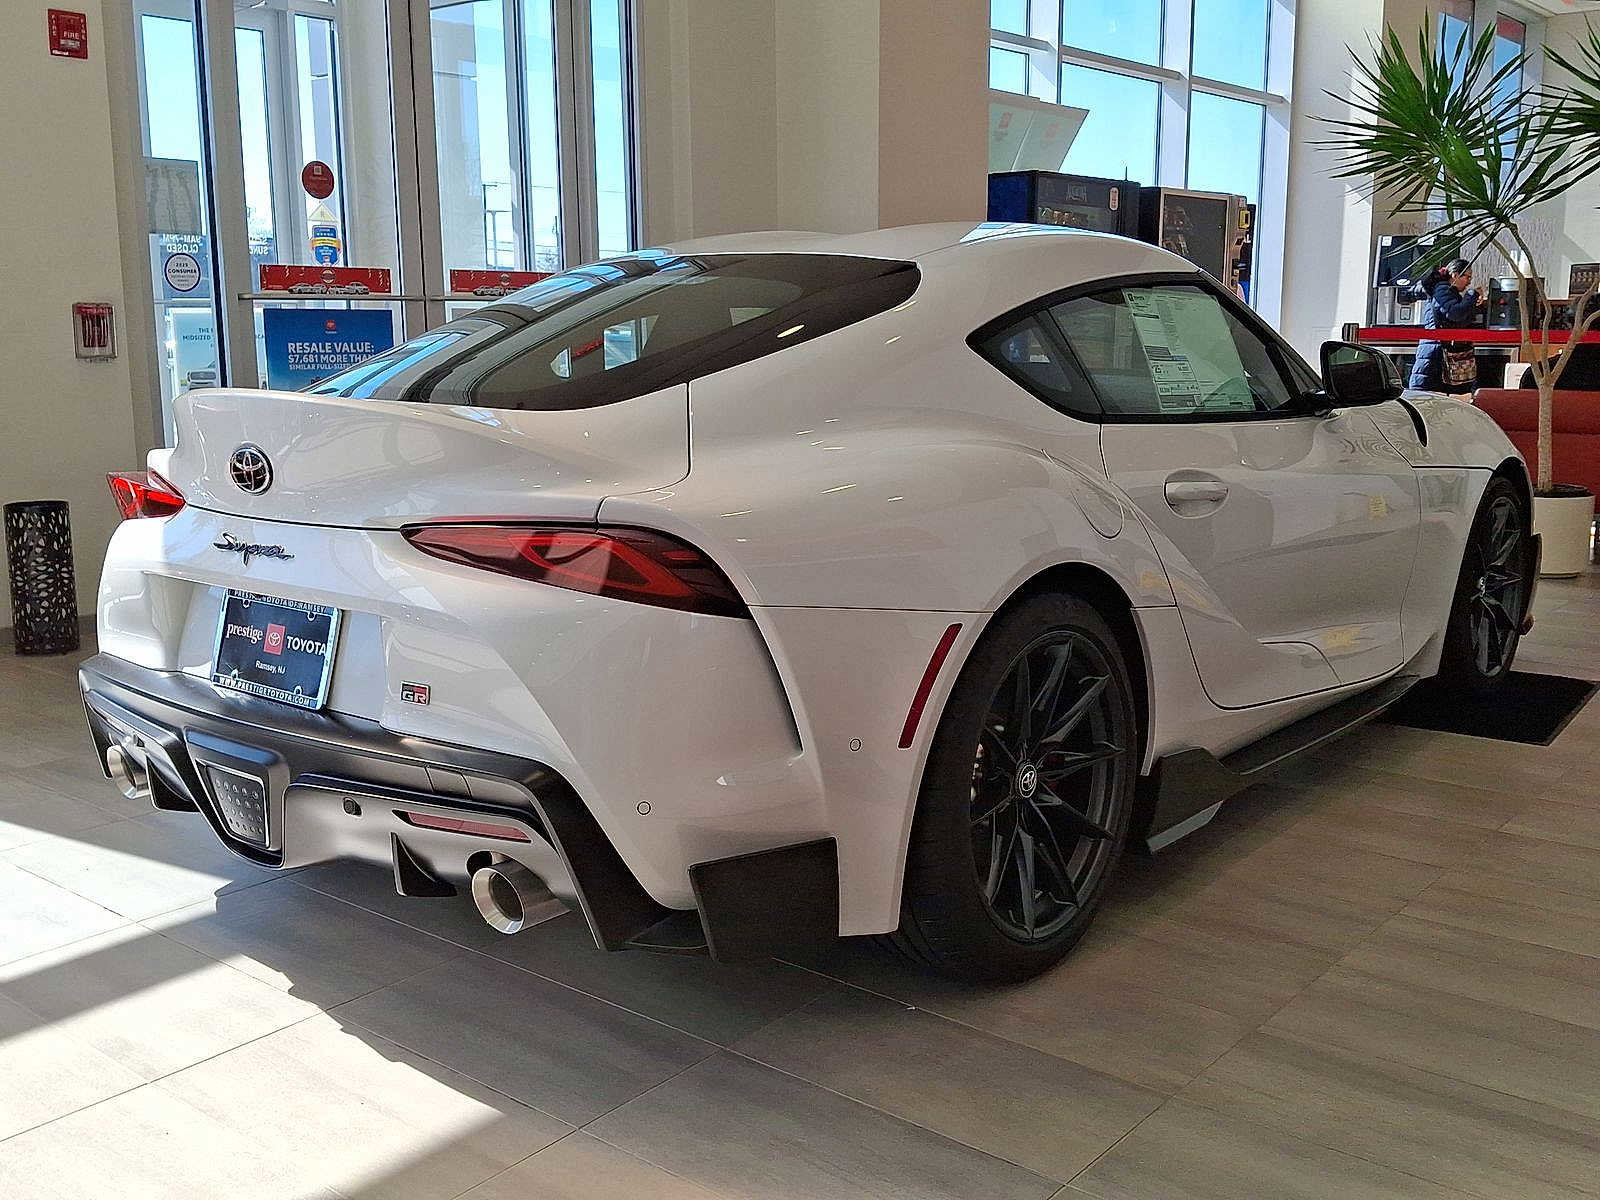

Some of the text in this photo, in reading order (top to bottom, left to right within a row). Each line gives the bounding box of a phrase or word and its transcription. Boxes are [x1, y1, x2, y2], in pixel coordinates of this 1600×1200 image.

[63, 31, 80, 40] FIRE
[288, 342, 375, 353] RESALE VALUE:
[288, 354, 319, 363] $7,681
[320, 354, 348, 363] MORE
[213, 532, 294, 566] Supra
[226, 623, 327, 657] prestige TOYOTA
[277, 665, 286, 674] NJ
[402, 691, 426, 704] GR
